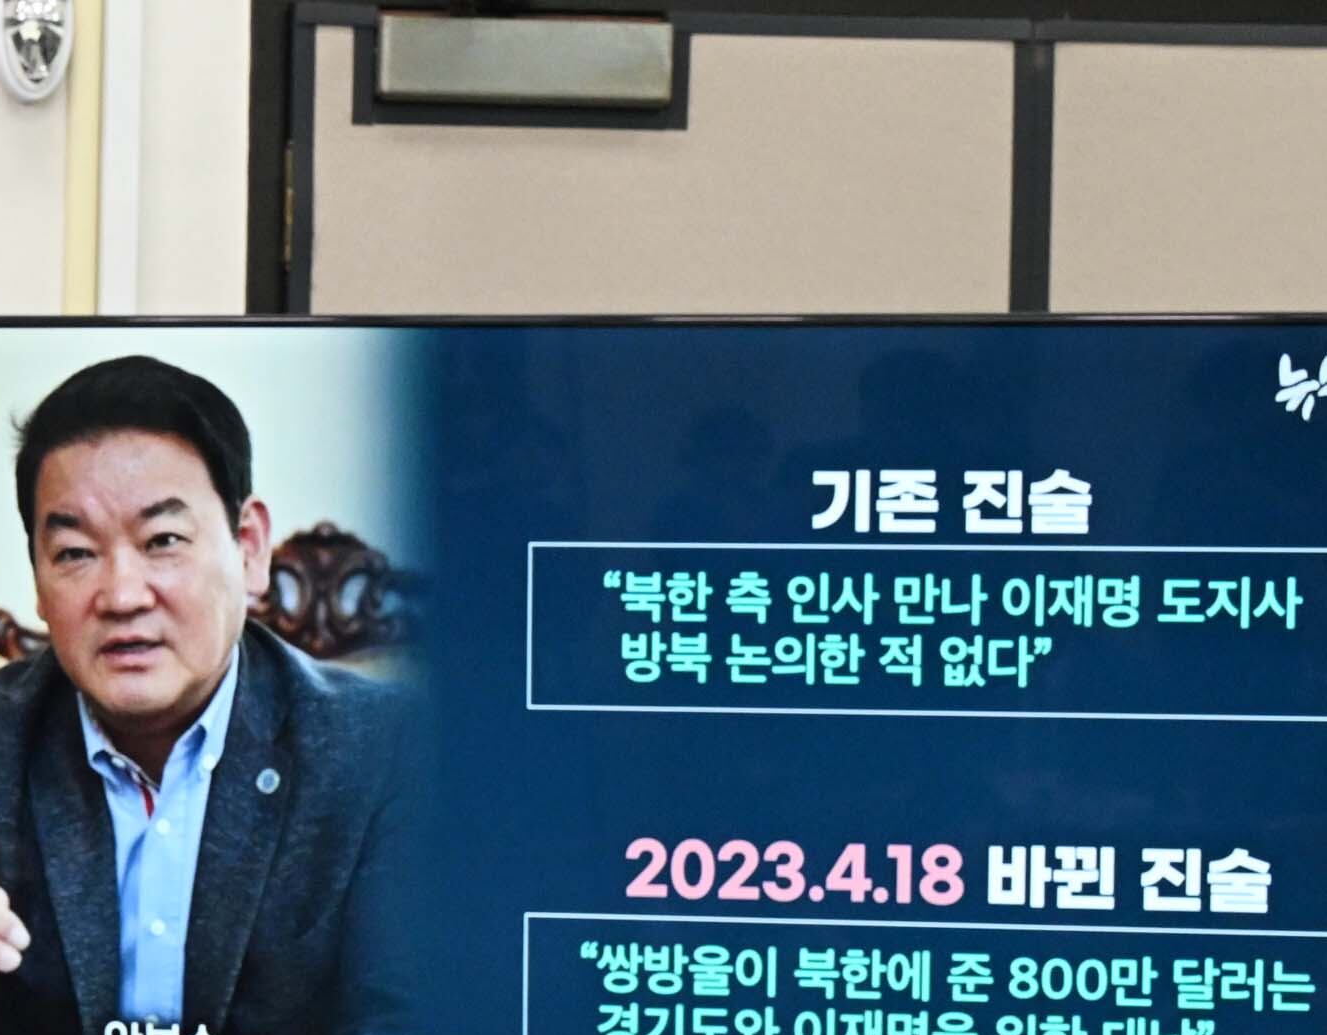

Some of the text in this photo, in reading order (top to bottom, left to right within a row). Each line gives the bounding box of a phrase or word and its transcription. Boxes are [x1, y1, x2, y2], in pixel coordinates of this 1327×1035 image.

[1274, 353, 1327, 421] 뉴
[811, 469, 1094, 535] 기존 진술
[725, 571, 772, 624] 측
[787, 573, 880, 625] 인사
[893, 574, 987, 627] 만나
[1001, 574, 1141, 628] 이재명
[1157, 576, 1304, 630] 도지사
[621, 632, 712, 683] 방북
[726, 634, 864, 686] 논의한
[879, 635, 923, 687] 적
[625, 838, 1272, 914] 2023.4.18 바뀐 진술
[793, 948, 932, 1002] 북한에
[947, 954, 995, 1004] 준
[1008, 956, 1157, 1008] 800만
[1173, 958, 1317, 1013] 달러는
